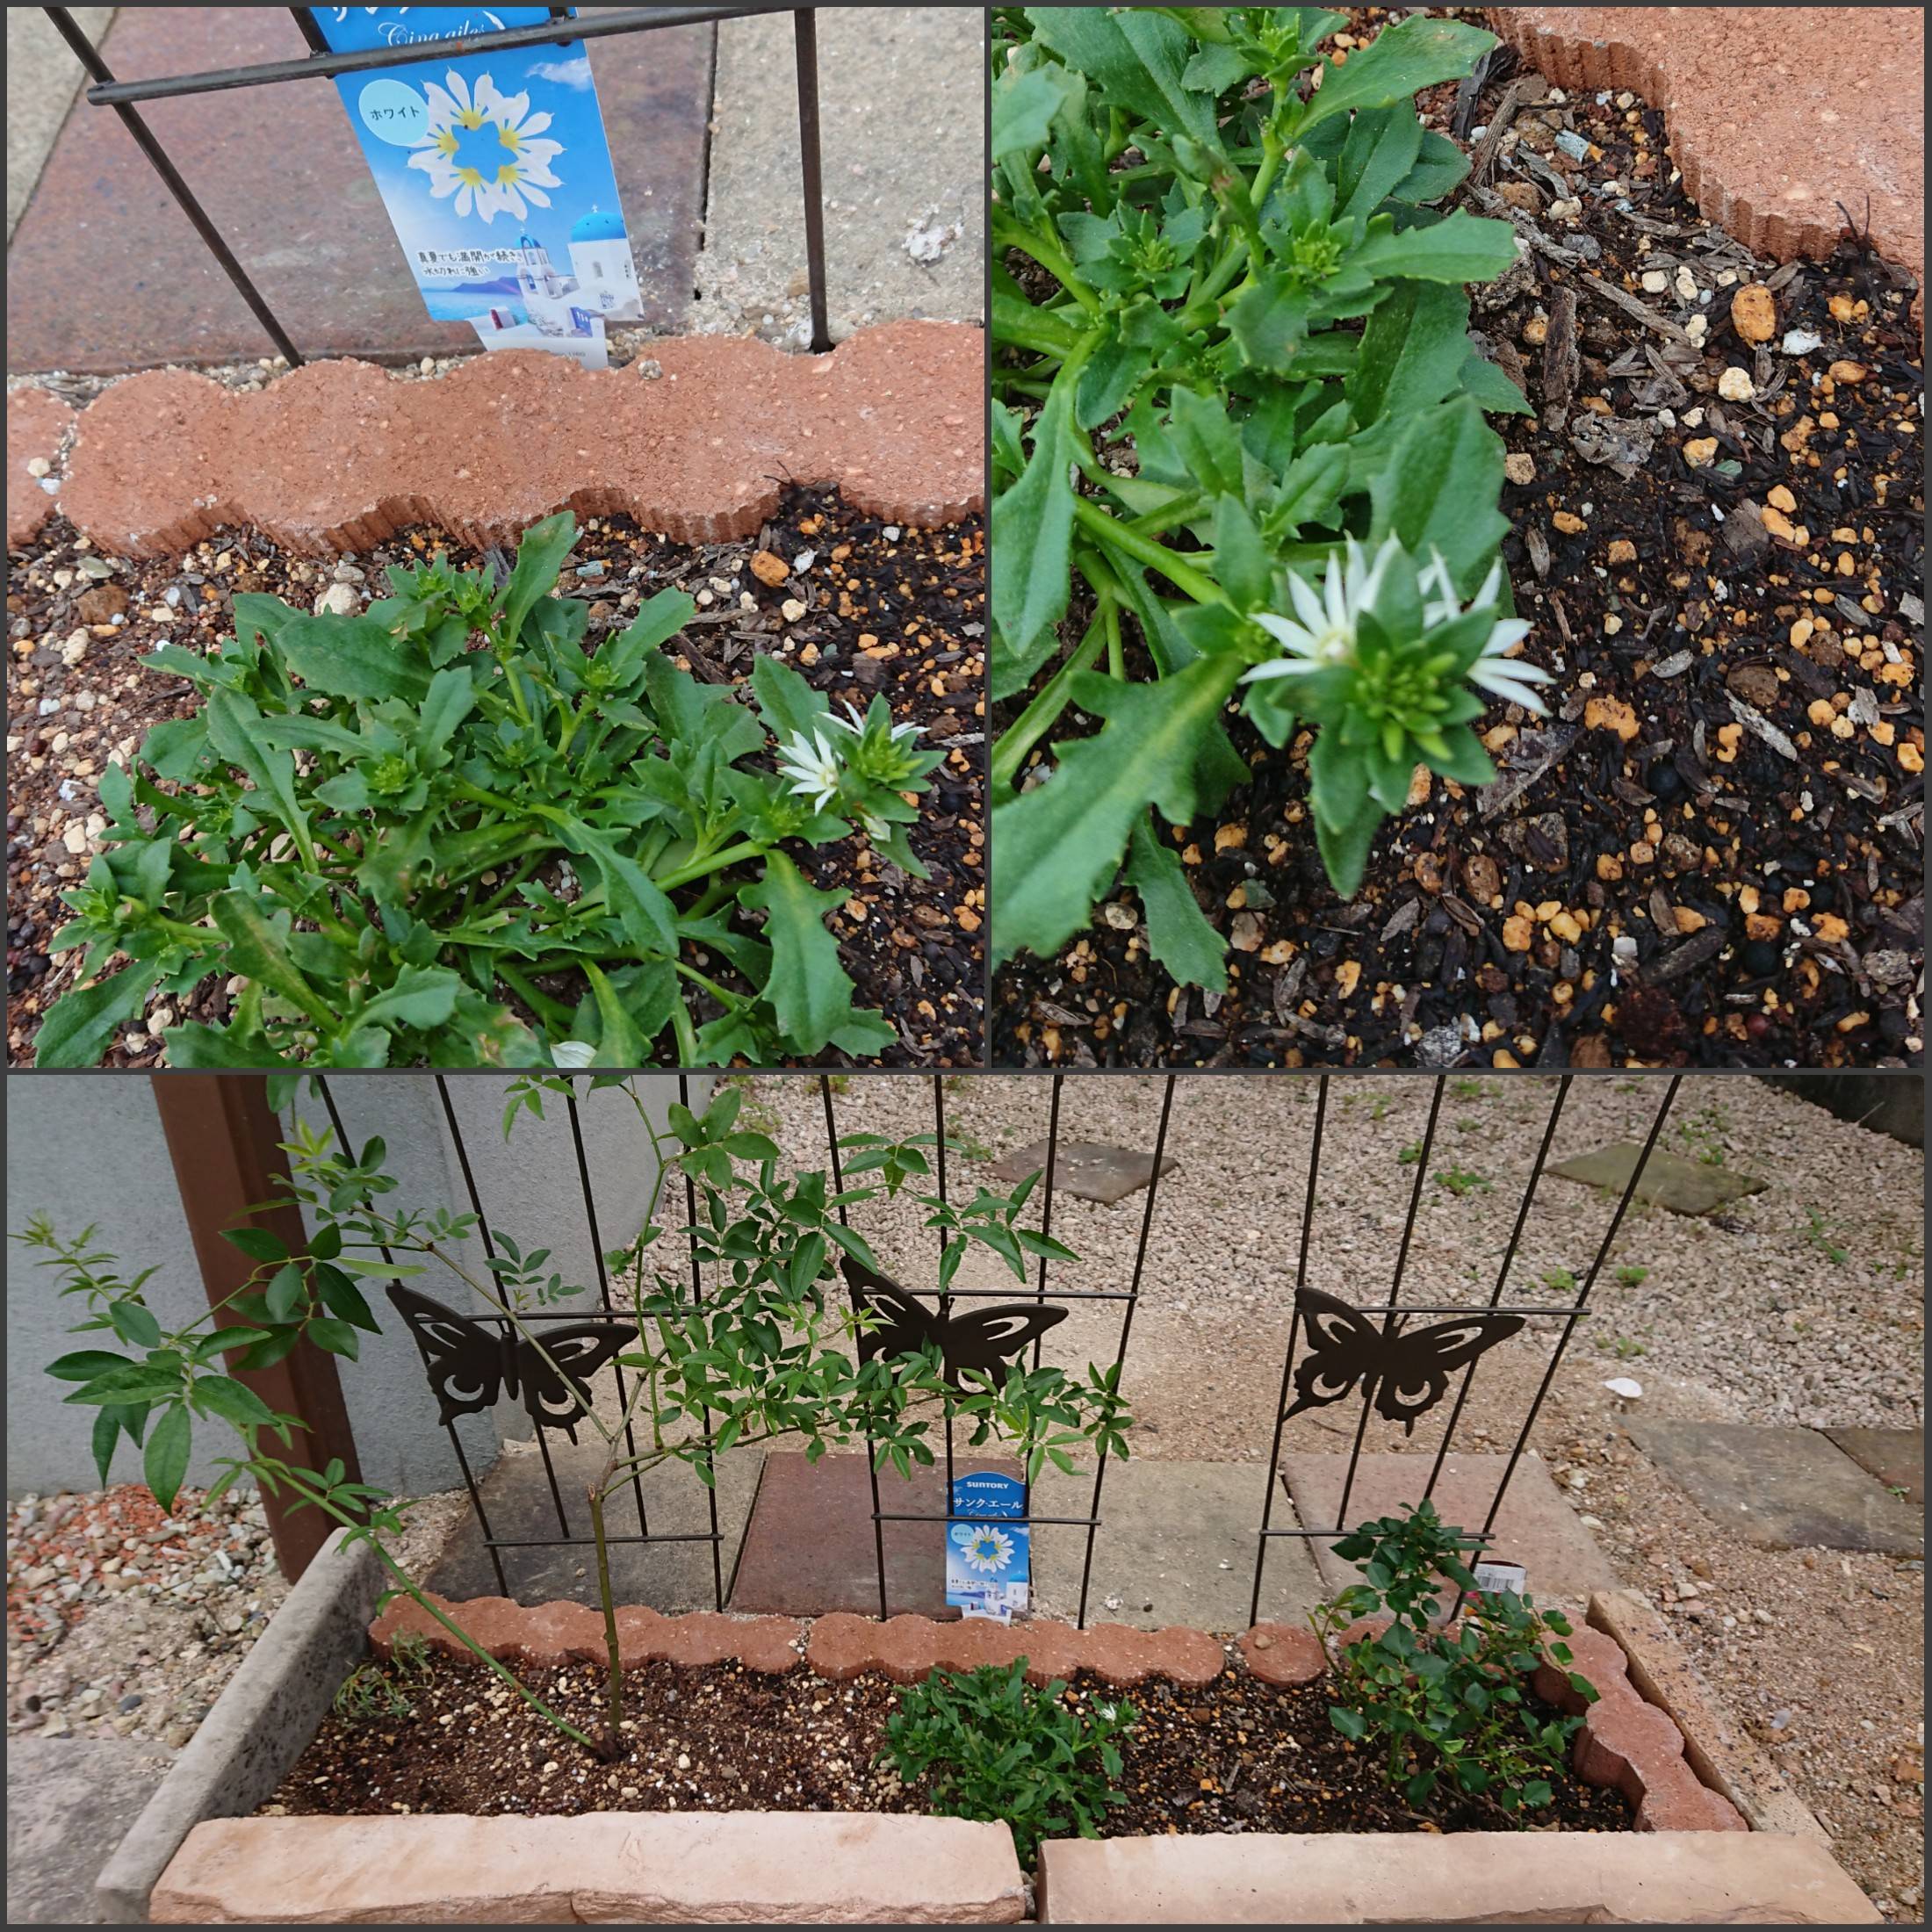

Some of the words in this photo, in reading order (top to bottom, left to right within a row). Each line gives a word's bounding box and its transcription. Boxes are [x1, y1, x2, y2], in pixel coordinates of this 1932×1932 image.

[370, 105, 420, 120] ホワイト
[966, 1481, 1009, 1489] SUNTORY
